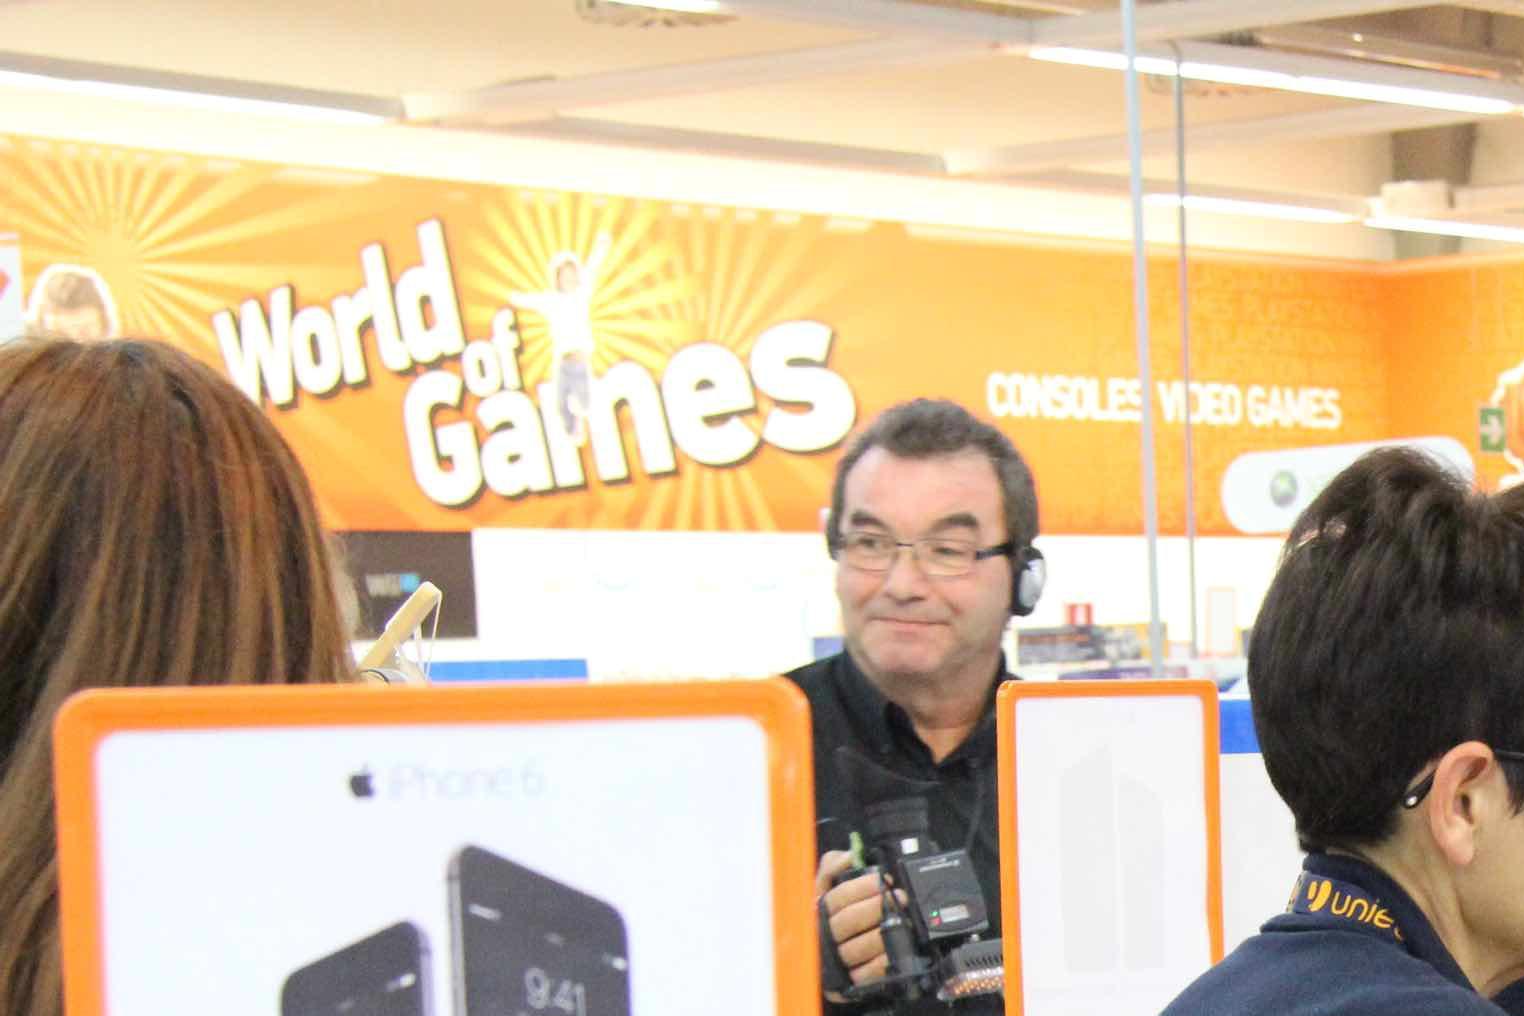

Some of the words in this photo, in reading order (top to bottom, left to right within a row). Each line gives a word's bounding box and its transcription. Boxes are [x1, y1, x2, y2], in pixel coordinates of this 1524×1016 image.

[213, 219, 465, 409] World
[463, 309, 523, 397] of
[403, 319, 858, 508] Games
[986, 371, 1142, 422] CONSOLES
[1156, 380, 1241, 425] VIDEO
[1248, 385, 1342, 430] GAMES
